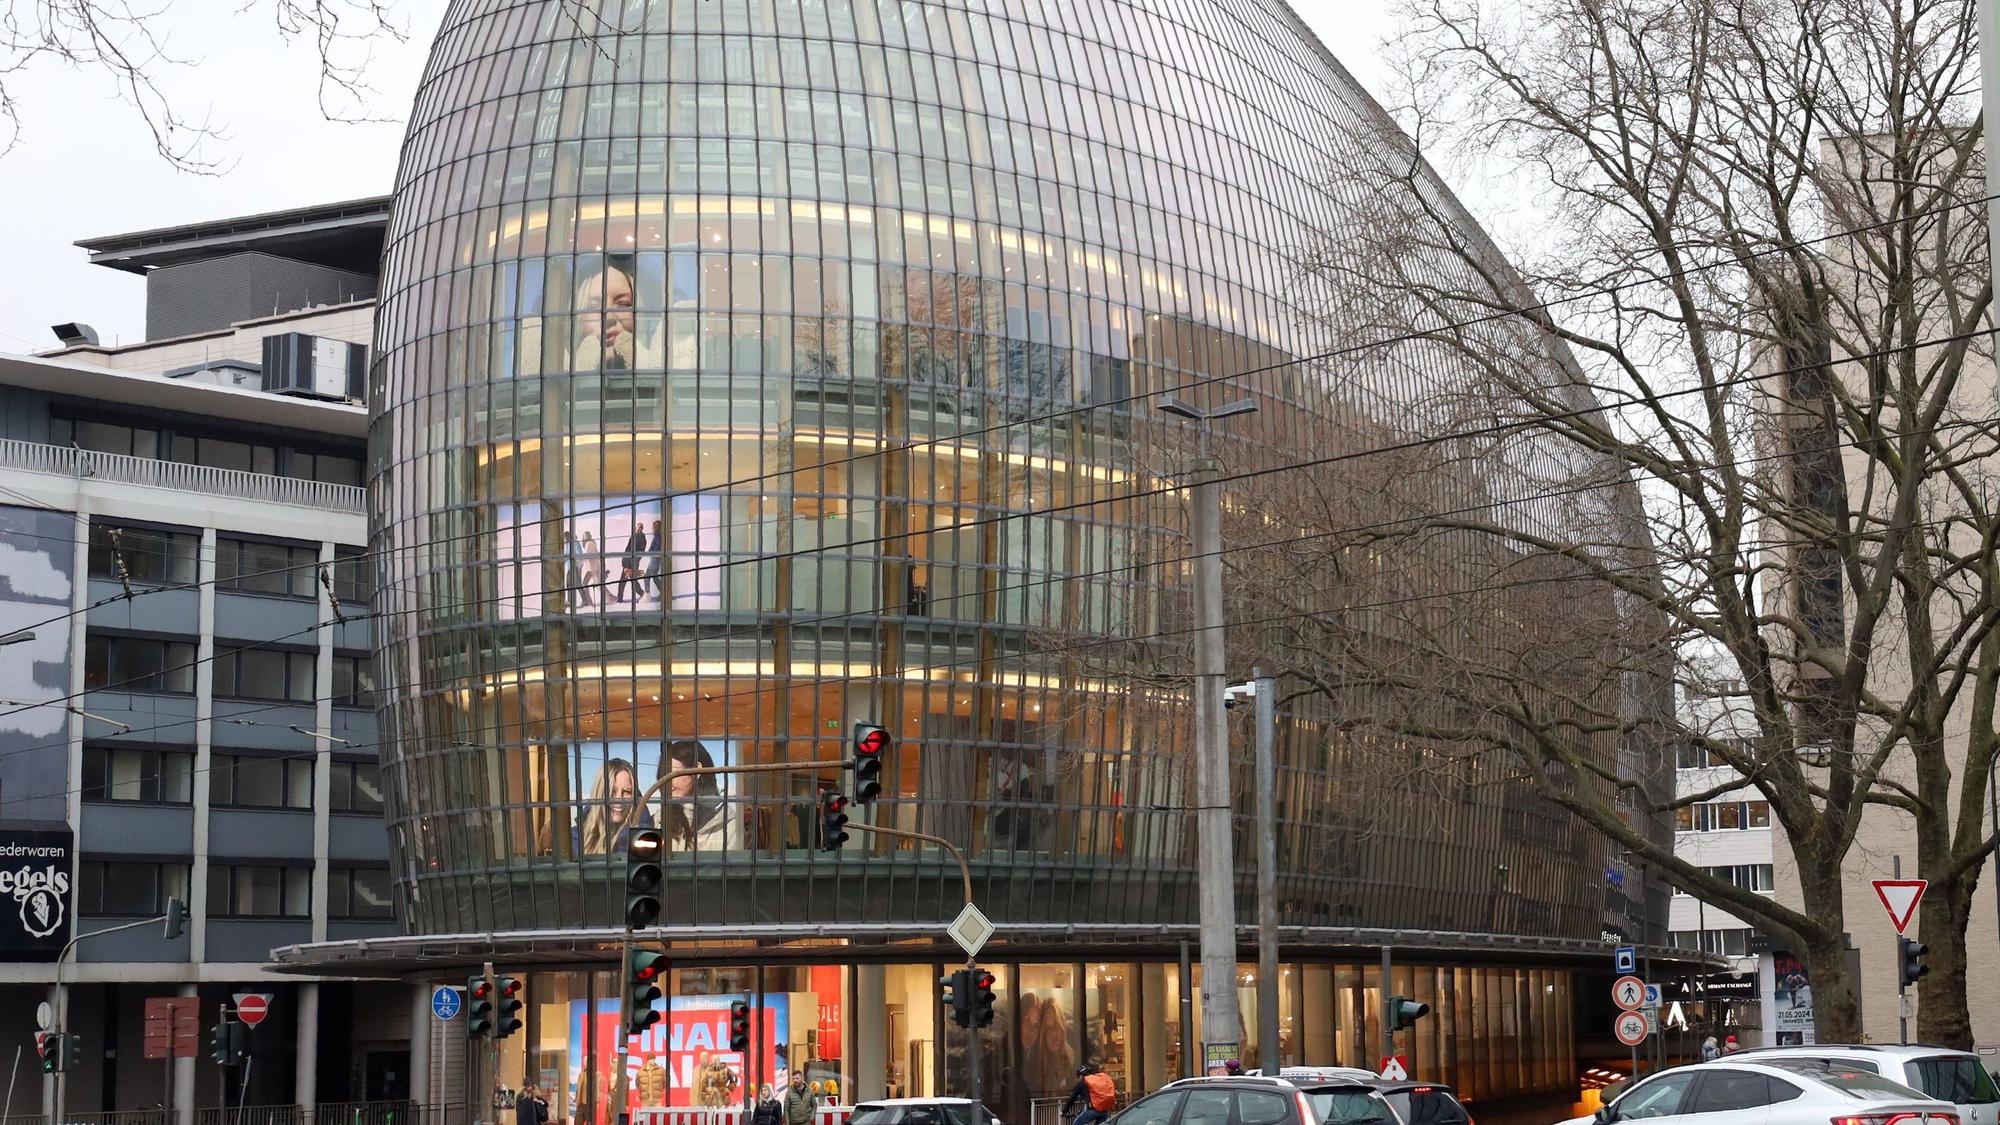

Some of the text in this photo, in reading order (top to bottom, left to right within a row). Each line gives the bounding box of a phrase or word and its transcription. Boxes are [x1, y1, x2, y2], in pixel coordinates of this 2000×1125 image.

[0, 841, 64, 858] ederwaren
[0, 864, 69, 902] egels
[1777, 1010, 1811, 1019] 21.05.2024
